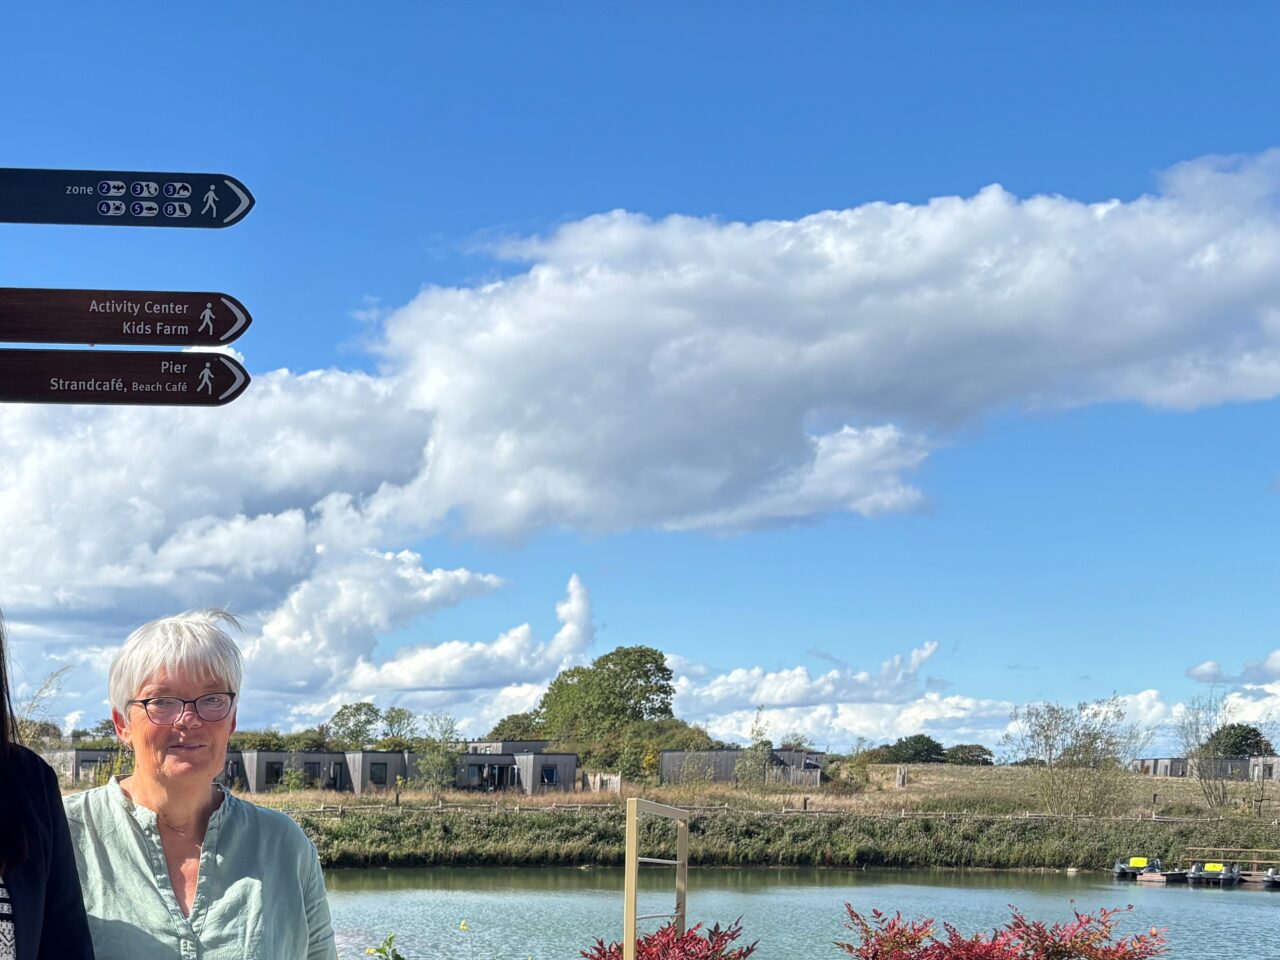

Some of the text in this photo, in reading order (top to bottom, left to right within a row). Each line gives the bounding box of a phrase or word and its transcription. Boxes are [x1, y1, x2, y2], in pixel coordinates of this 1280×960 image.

[66, 186, 94, 195] zone
[89, 300, 189, 316] Activity Center
[123, 321, 189, 335] Kids Farm
[161, 361, 187, 374] Pier
[50, 377, 187, 393] Strandcafé, Beach Café
